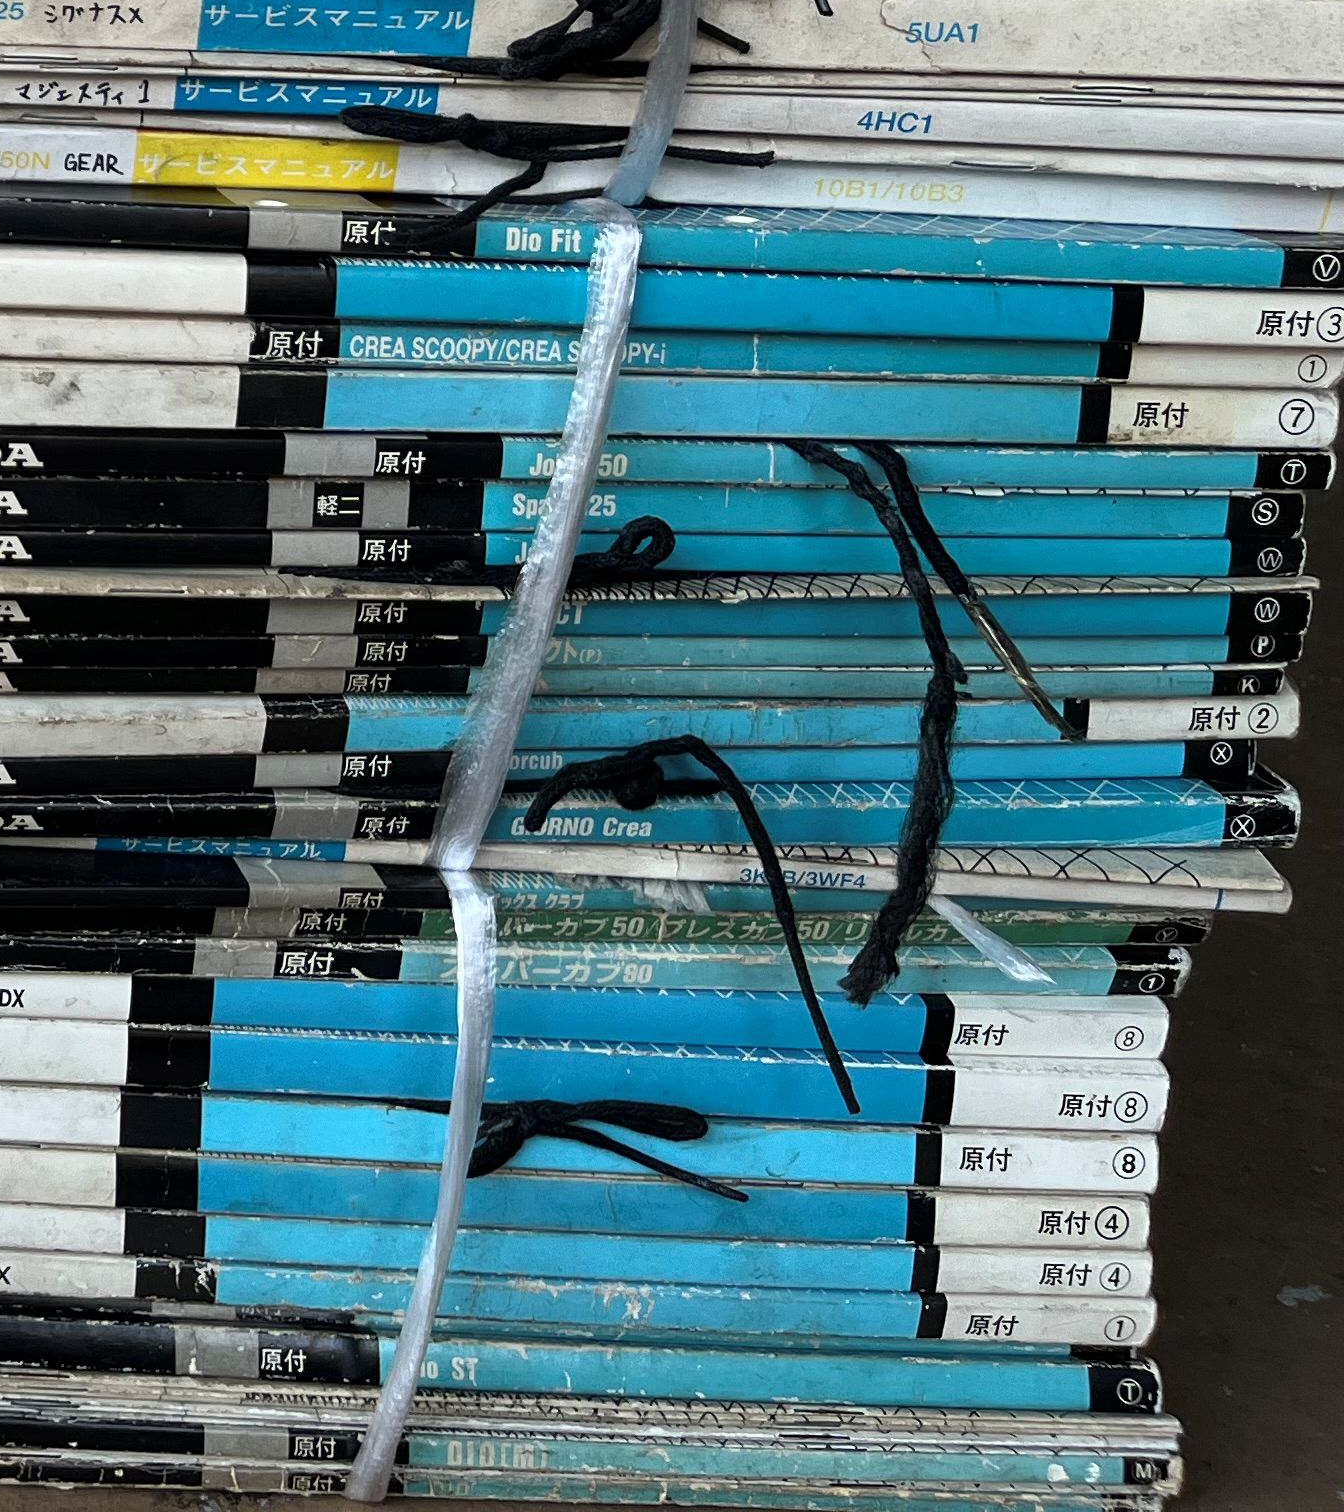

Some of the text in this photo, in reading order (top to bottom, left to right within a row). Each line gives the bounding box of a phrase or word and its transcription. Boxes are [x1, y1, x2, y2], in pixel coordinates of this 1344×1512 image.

[205, 5, 471, 31] サービスマニュアル
[905, 23, 980, 44] 5UA1
[857, 112, 933, 133] 4HC1
[64, 153, 124, 174] GEAR
[506, 226, 581, 253] Dio Fit
[266, 332, 561, 363] 原付 CREA SCOOPY/CREA
[1133, 403, 1188, 427] 原付
[375, 451, 426, 474] 原付
[317, 495, 360, 516] 軽二
[362, 540, 412, 562] 原付
[603, 817, 652, 837] Crea
[280, 951, 335, 974] 原付
[954, 1024, 1009, 1046] 原付
[1057, 1095, 1113, 1117] 原付
[959, 1147, 1012, 1171] 原付
[1038, 1211, 1090, 1234] 原付
